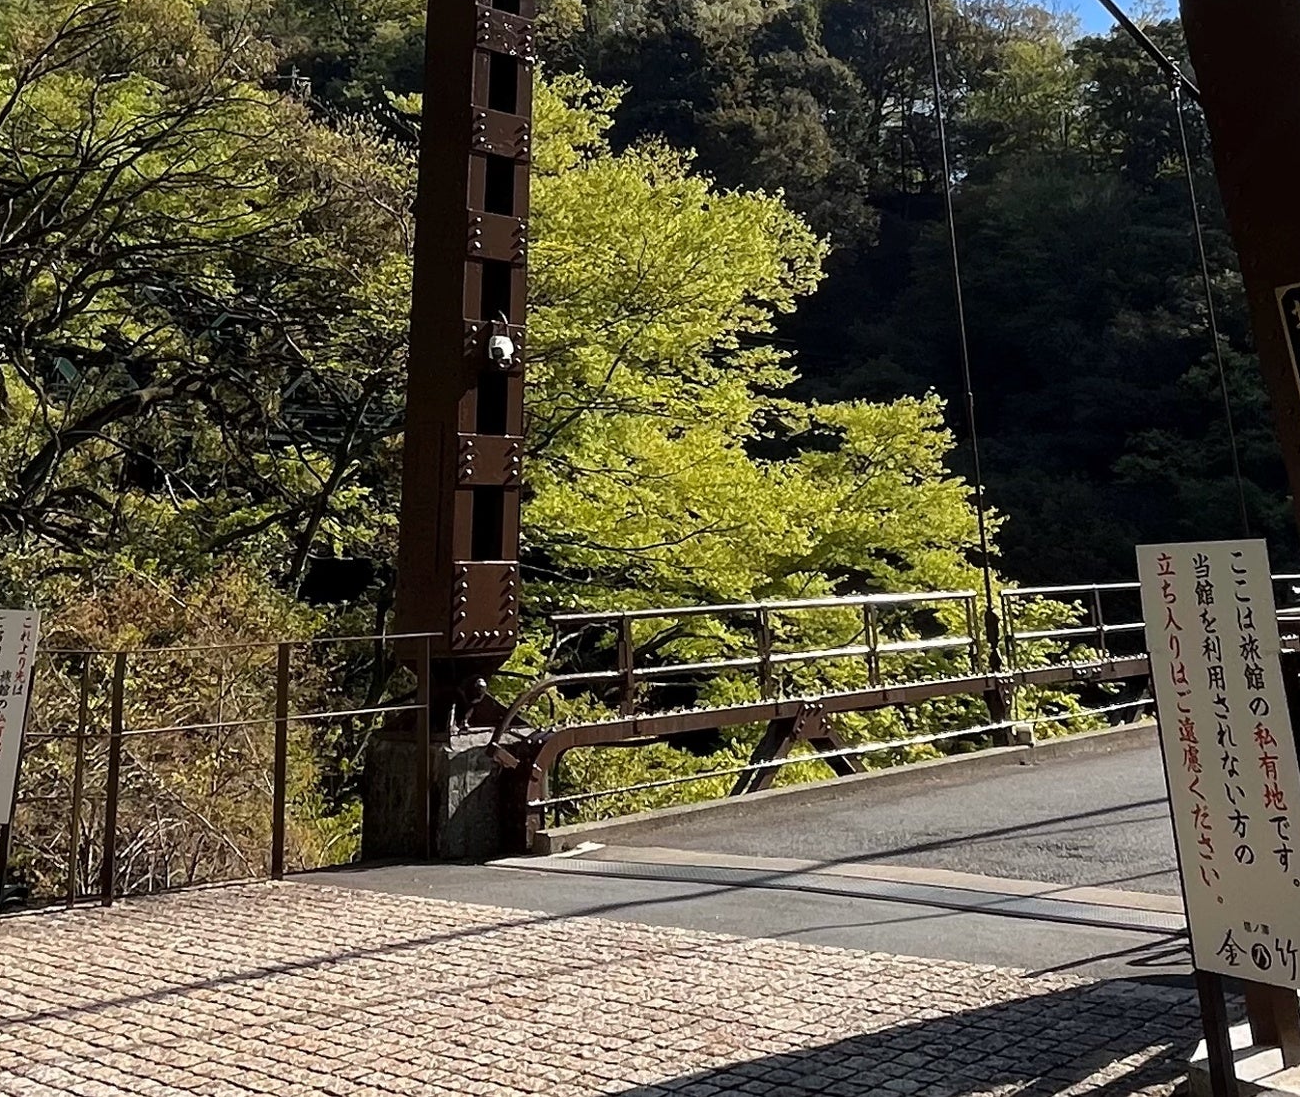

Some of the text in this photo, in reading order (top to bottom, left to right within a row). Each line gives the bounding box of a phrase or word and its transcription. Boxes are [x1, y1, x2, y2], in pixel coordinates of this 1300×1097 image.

[11, 616, 32, 696] これより先は
[1155, 551, 1225, 905] 立ち入りはご遠慮ください。
[1191, 553, 1255, 866] 当館を利用されない方の
[1229, 550, 1300, 889] ここは旅館の私有地です。
